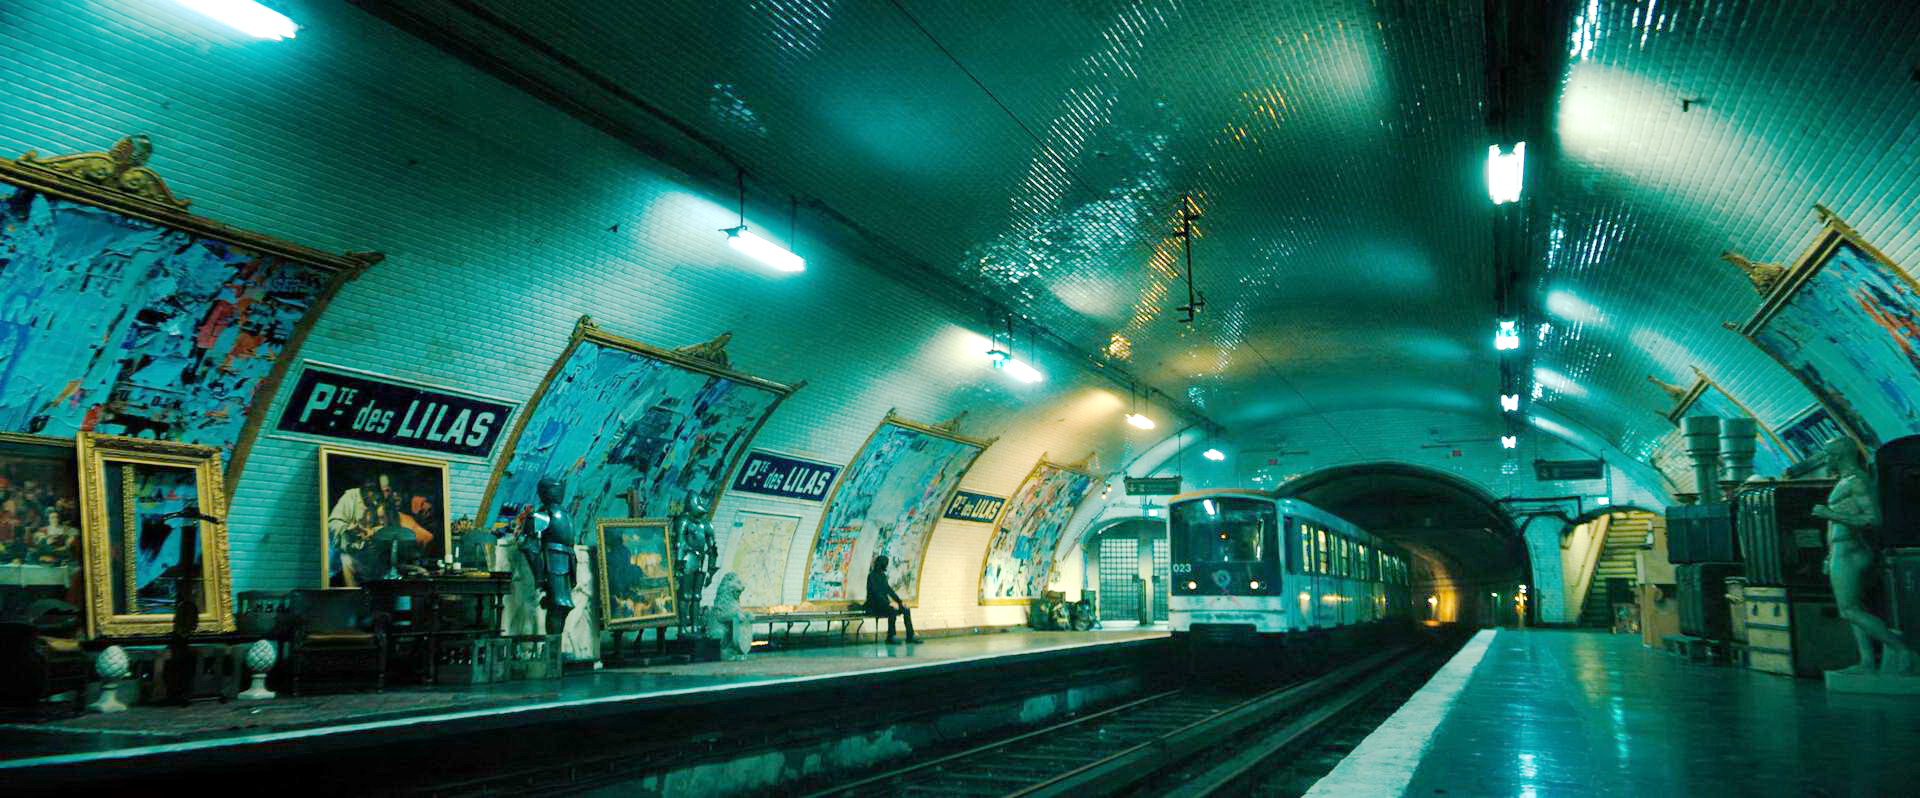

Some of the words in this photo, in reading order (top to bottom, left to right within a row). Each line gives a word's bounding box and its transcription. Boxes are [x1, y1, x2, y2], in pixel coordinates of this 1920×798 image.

[352, 399, 395, 434] des
[396, 400, 496, 446] LILAS
[763, 467, 784, 490] des
[782, 467, 831, 494] LILAS
[971, 498, 1001, 519] LILAS
[1173, 563, 1192, 573] 023
